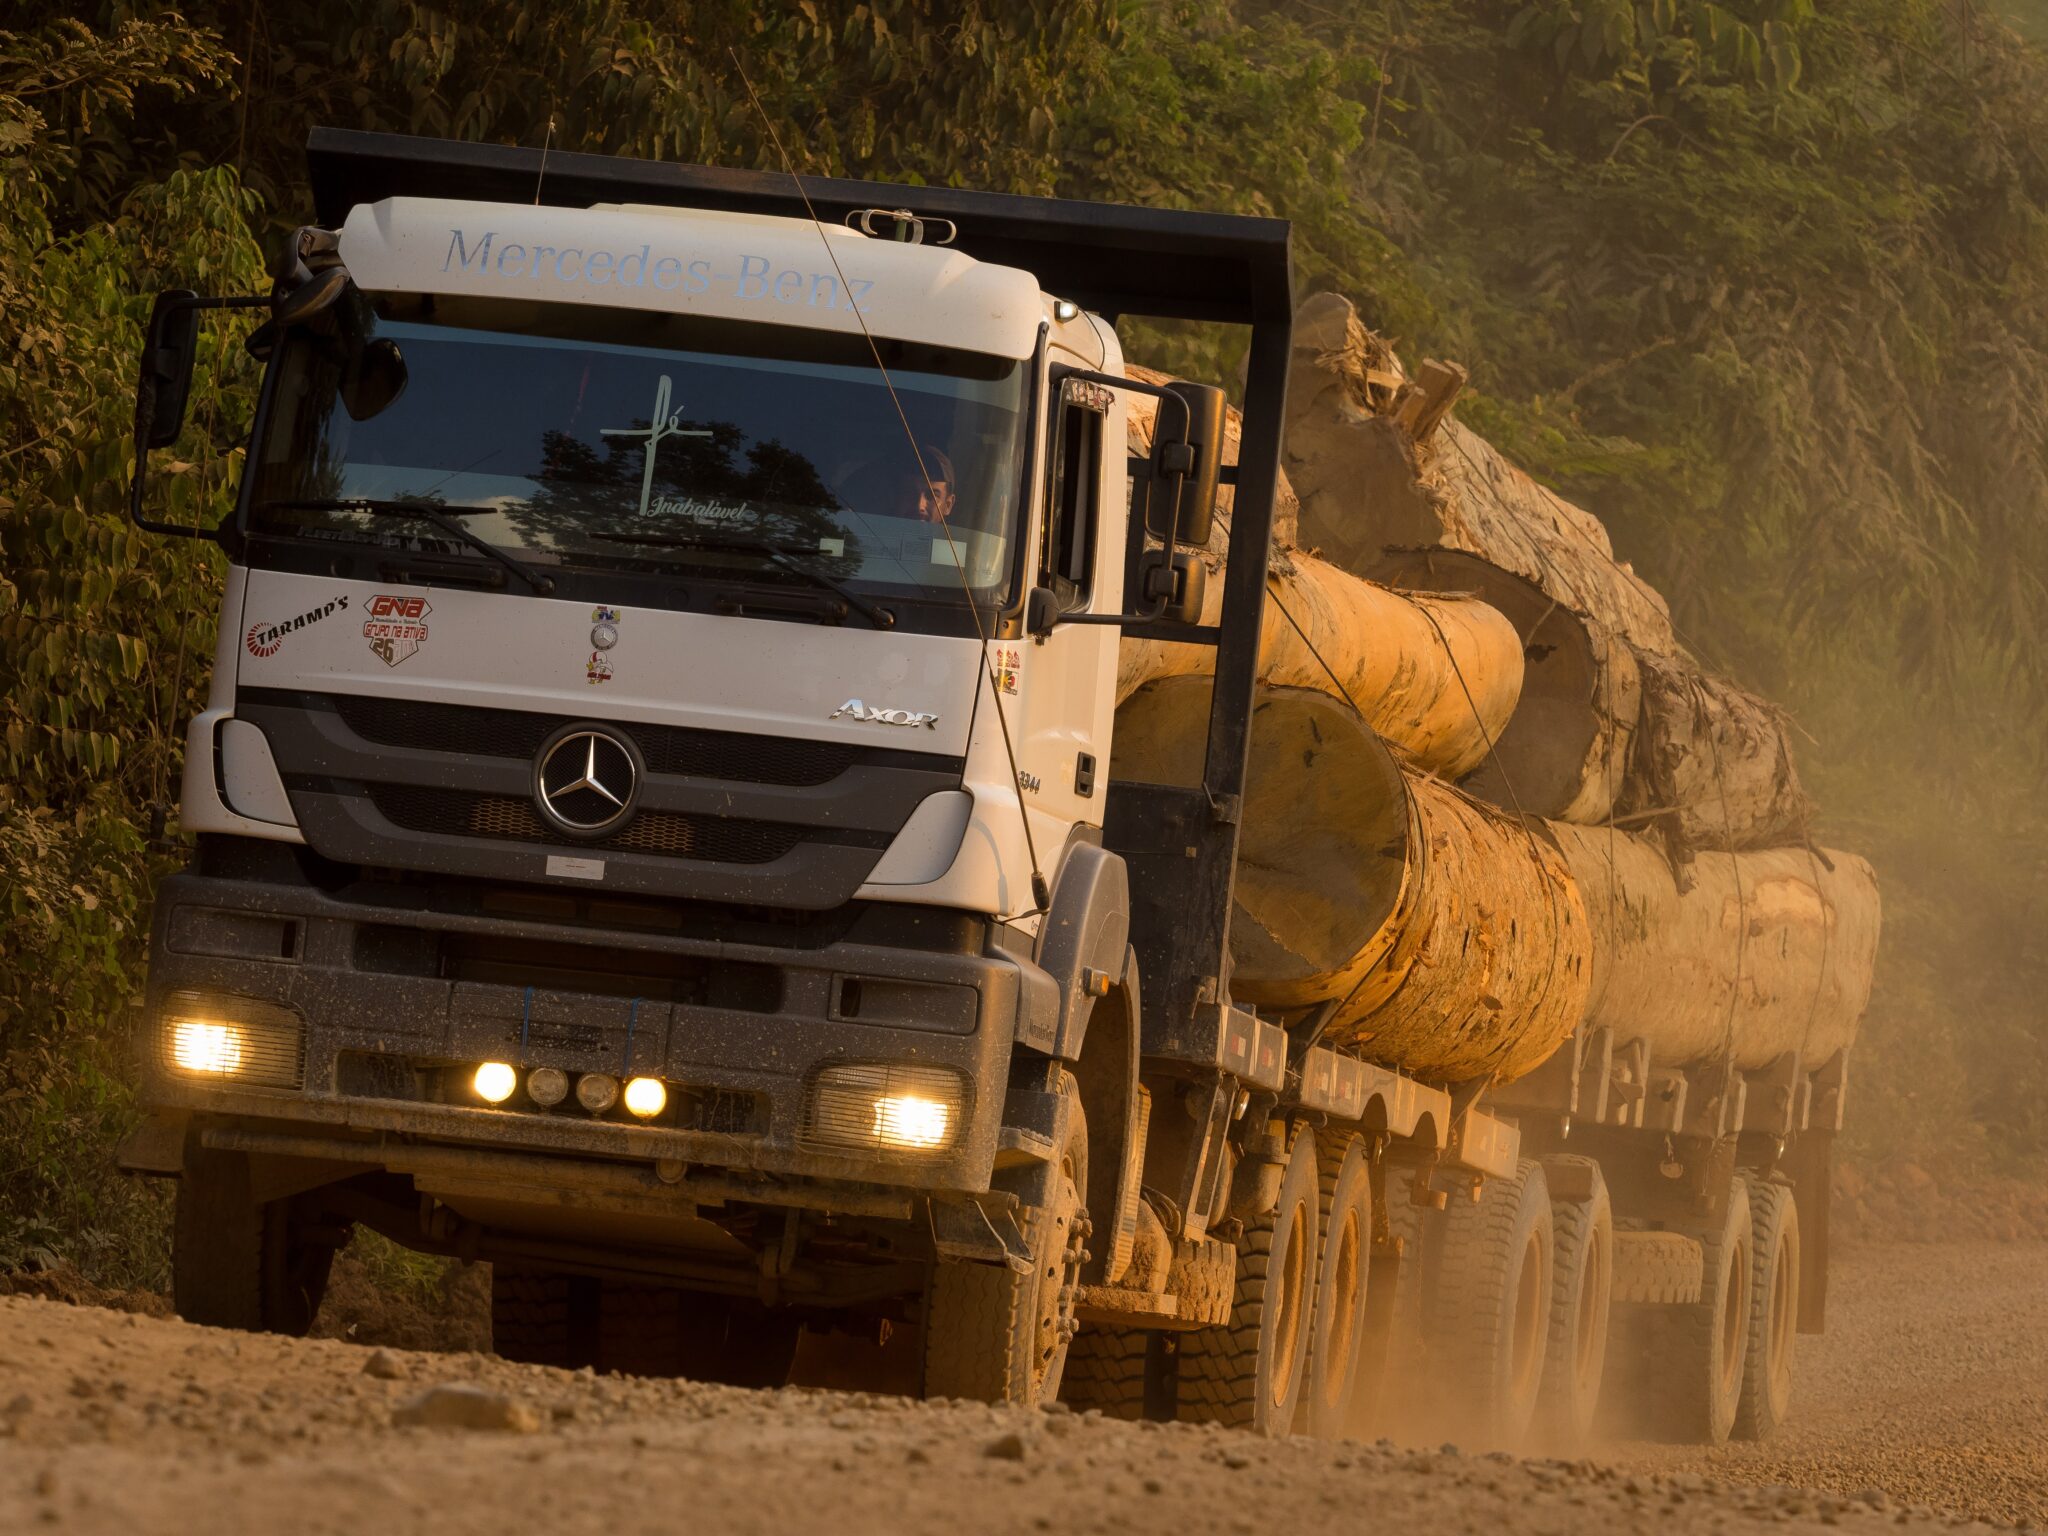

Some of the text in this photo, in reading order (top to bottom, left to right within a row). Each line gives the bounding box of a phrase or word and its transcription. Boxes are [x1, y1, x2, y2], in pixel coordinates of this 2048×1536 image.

[439, 228, 876, 314] Mercedes-Benz
[256, 595, 349, 645] TARAMP'S
[372, 637, 395, 664] 26
[828, 698, 939, 731] AXOR
